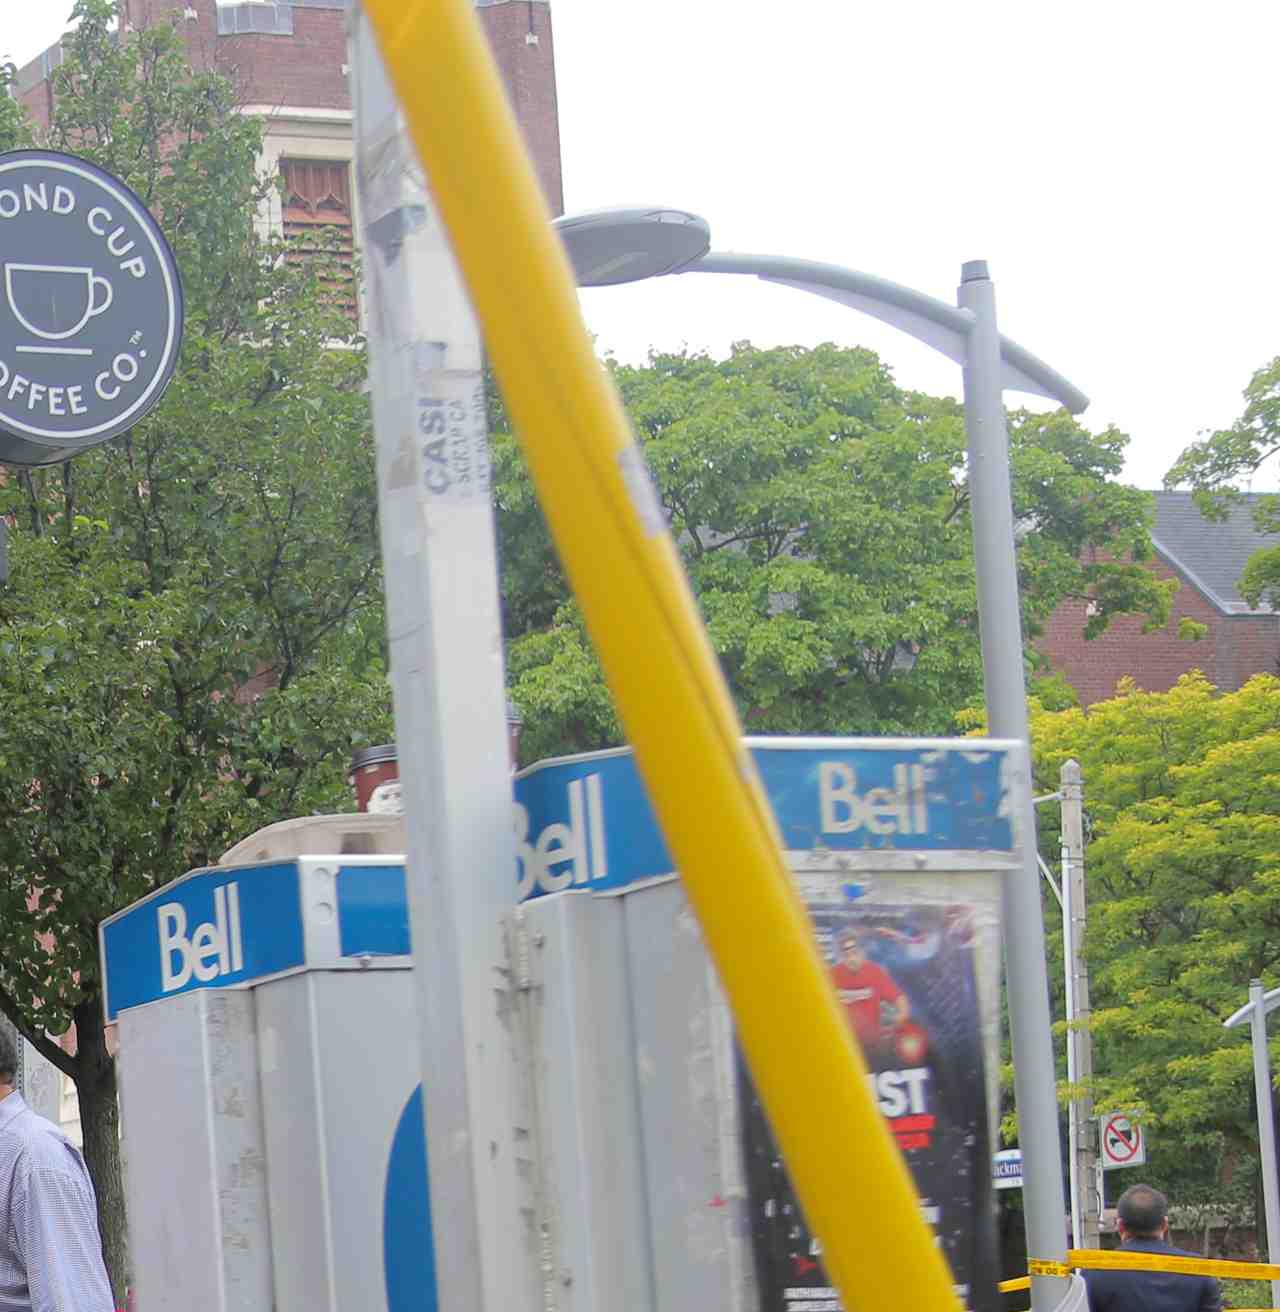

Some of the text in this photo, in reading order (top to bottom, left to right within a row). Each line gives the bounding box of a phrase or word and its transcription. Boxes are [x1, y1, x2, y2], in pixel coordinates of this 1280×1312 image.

[88, 206, 146, 278] CUP
[95, 350, 147, 400] CO.
[819, 759, 929, 836] Bell
[156, 882, 243, 992] Bell
